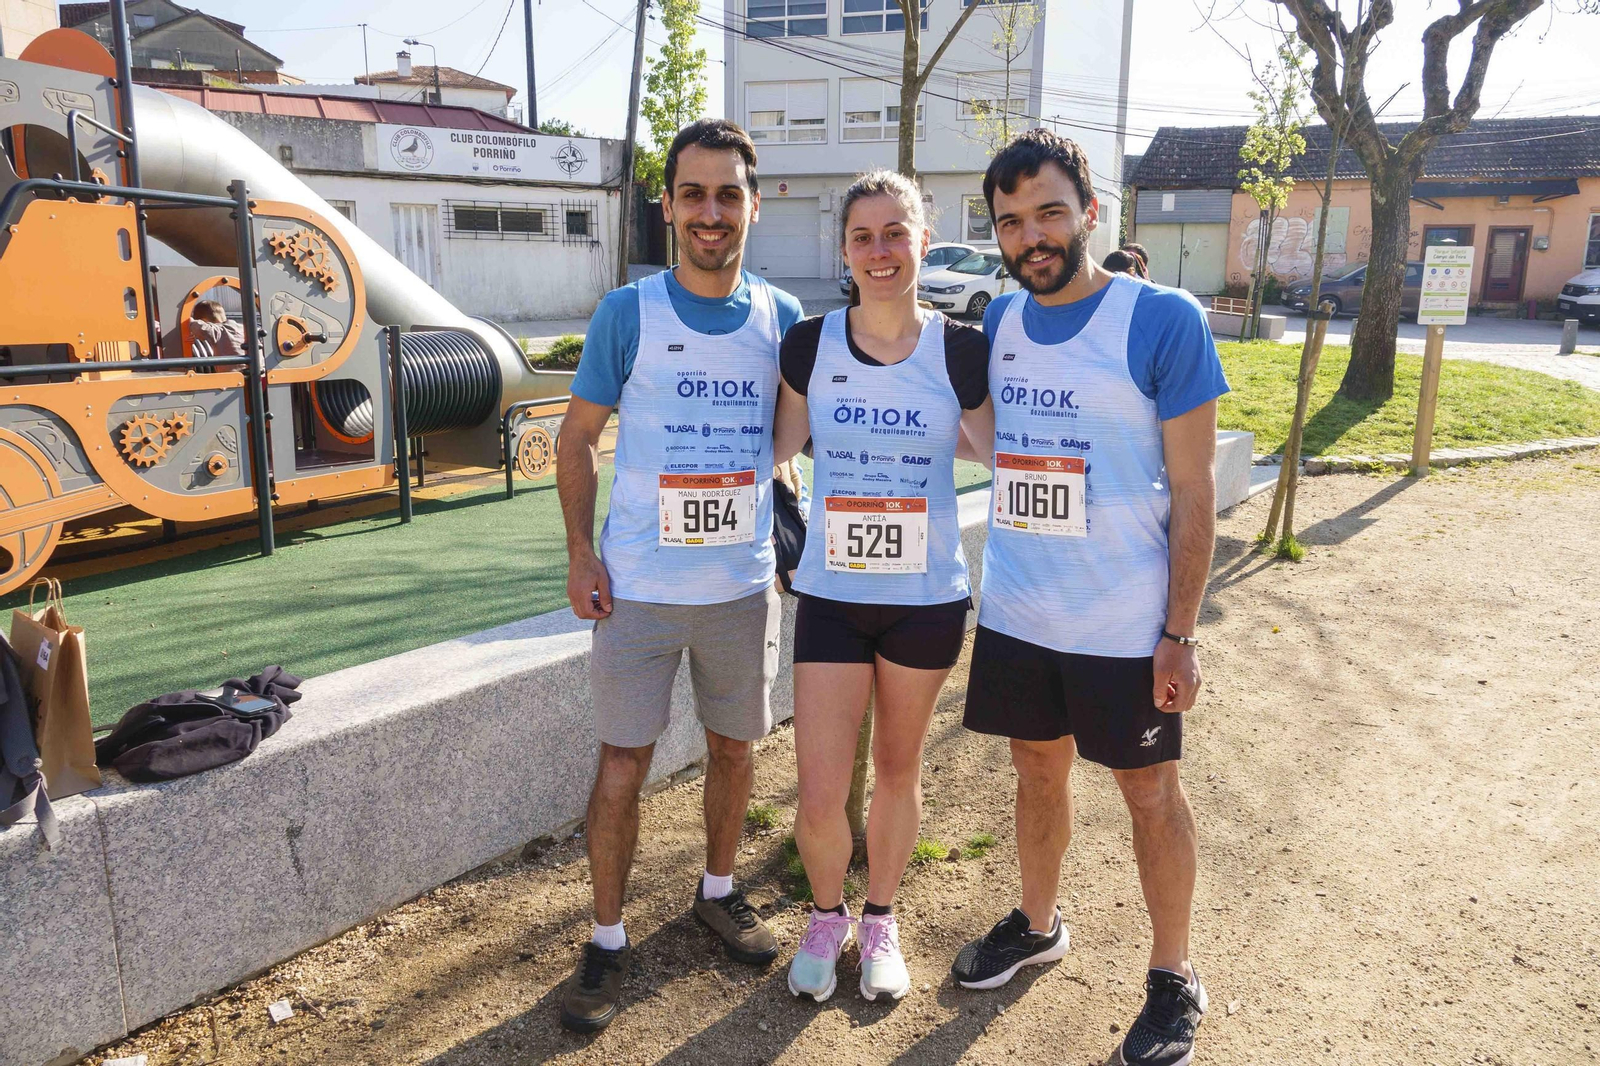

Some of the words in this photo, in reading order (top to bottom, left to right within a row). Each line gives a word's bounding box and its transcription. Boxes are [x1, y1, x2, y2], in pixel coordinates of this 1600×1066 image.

[392, 134, 402, 147] CLUB
[450, 133, 473, 144] CLUB
[476, 134, 536, 148] COLOMBÓFILO
[473, 147, 516, 160] PORRIÑO
[1000, 432, 1017, 441] LASAL
[1060, 439, 1091, 451] GADIS
[833, 451, 856, 459] LASAL
[902, 455, 932, 465] GADIS
[1016, 458, 1045, 467] PORRIÑO
[702, 489, 741, 497] RODRÍGUEZ
[1008, 481, 1069, 520] 1060
[684, 499, 737, 533] 964
[848, 524, 902, 558] 529
